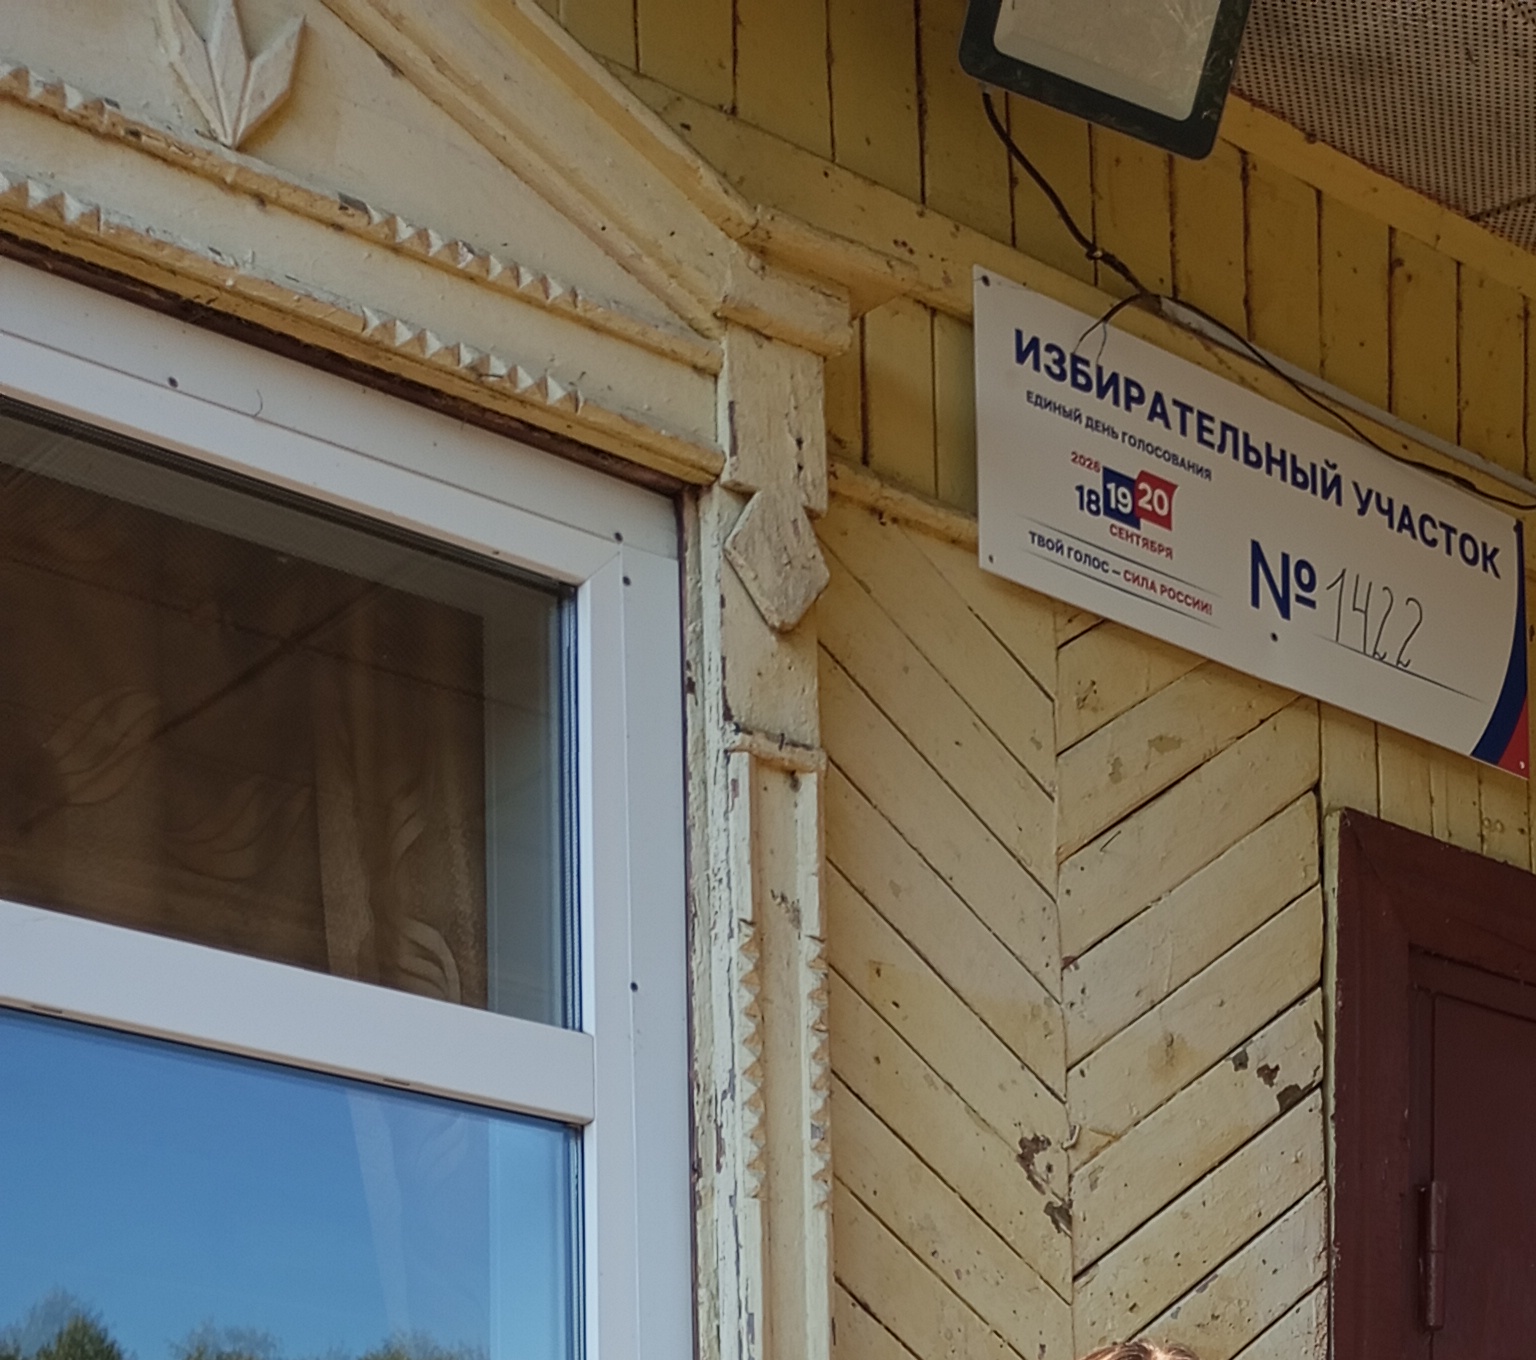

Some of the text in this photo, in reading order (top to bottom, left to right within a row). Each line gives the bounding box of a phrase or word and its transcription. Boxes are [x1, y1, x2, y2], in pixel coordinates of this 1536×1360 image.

[1015, 328, 1501, 579] ИЗБИРАТЕЛЬНЫЙ УЧАСТОК
[1026, 390, 1212, 481] ЕДИНЫЙ ДЕНЬ ГОЛОСОВАНИЯ
[1075, 482, 1169, 517] 18 19 20
[1109, 523, 1173, 560] СЕНТЯБРЯ
[1029, 530, 1064, 556] ТВОЙ
[1067, 546, 1109, 574] ГОЛОС
[1123, 569, 1157, 593] СИЛА
[1160, 584, 1212, 616] РОССИИ!
[1325, 567, 1423, 668] 1422
